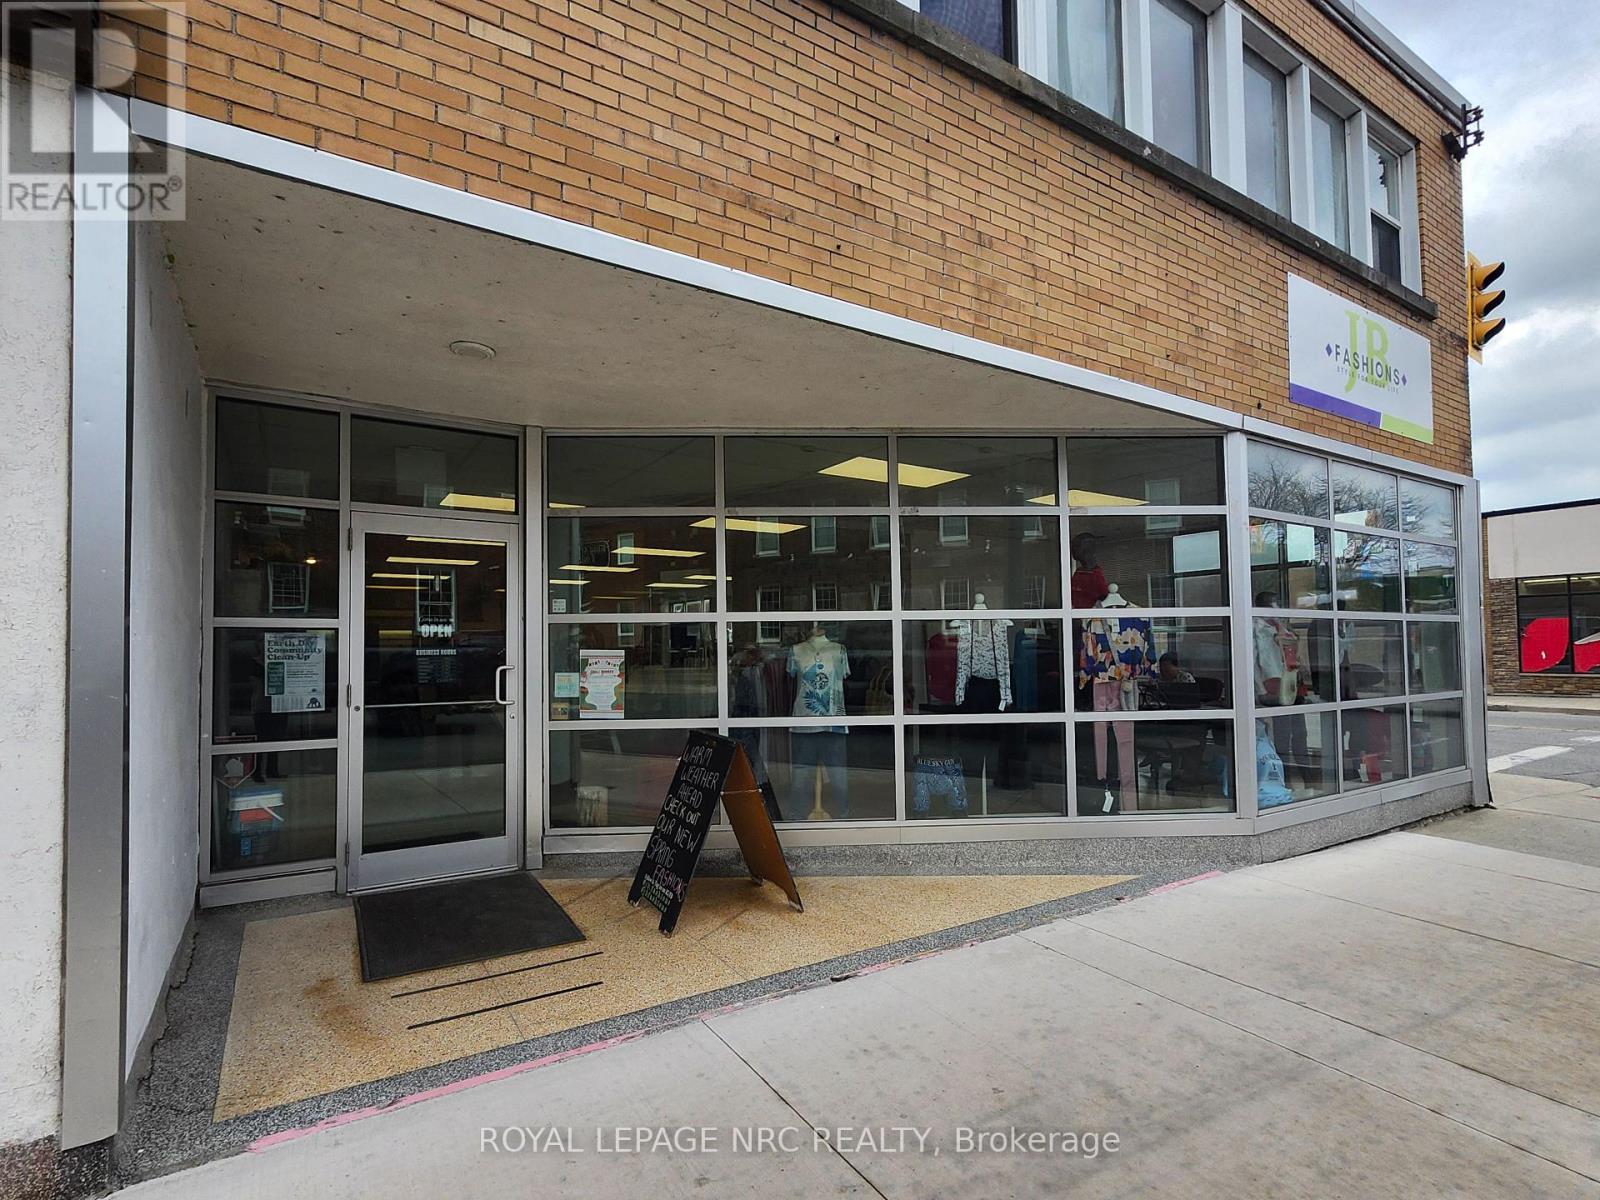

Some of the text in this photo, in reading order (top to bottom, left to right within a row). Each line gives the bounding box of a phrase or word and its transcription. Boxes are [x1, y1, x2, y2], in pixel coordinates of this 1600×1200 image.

[1334, 343, 1401, 385] FASHIONS
[267, 639, 296, 648] Earth
[421, 623, 452, 638] OPEN
[267, 646, 323, 655] Community
[267, 653, 312, 661] Clean-Up
[682, 744, 713, 767] WARM
[680, 765, 720, 791] WEATHER
[677, 783, 703, 809] AHEAD
[664, 794, 702, 826] CHECK OUT
[656, 813, 702, 853] OUR NEW
[647, 834, 677, 868] SPRING
[653, 864, 688, 903] FASHIONS
